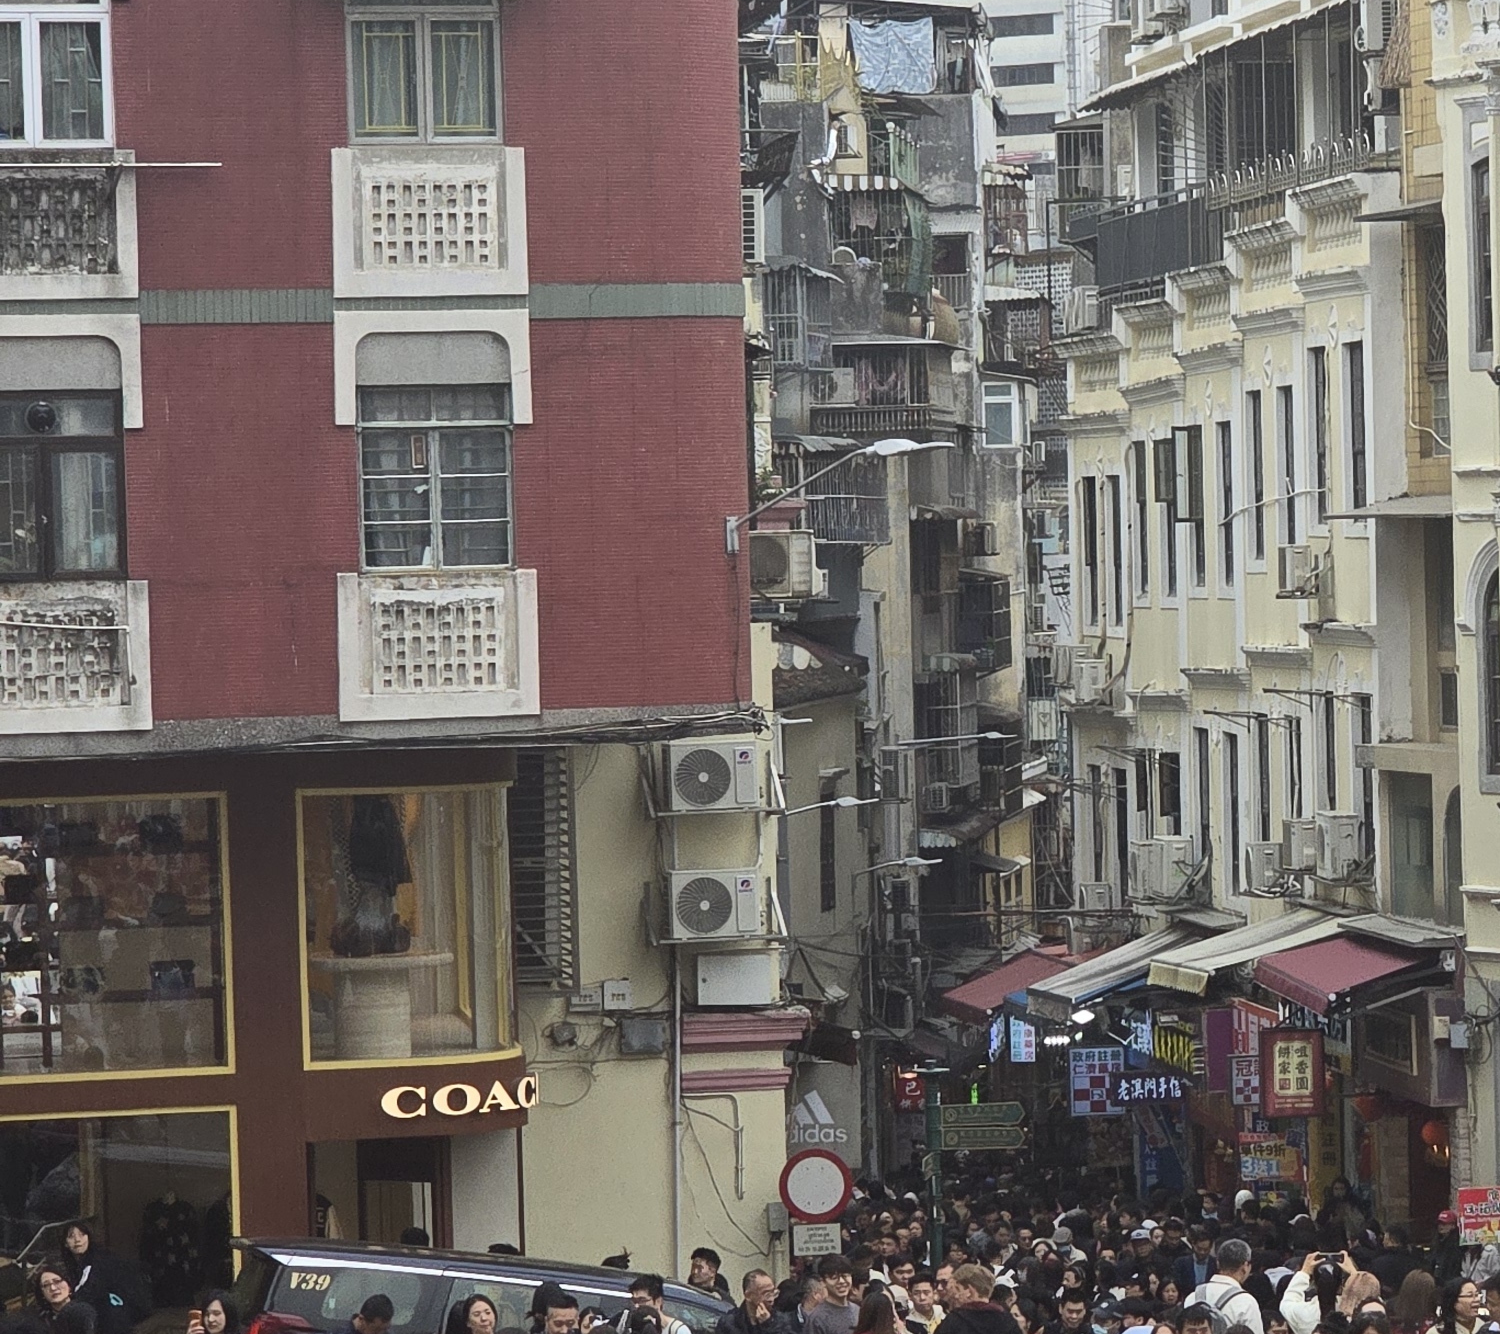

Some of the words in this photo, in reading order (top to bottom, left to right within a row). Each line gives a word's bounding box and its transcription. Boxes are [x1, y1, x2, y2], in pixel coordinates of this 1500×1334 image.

[1278, 1046, 1291, 1075] 餅家
[1294, 1046, 1309, 1091] 咀香園
[381, 1071, 539, 1118] COAC
[290, 1271, 331, 1291] V39
